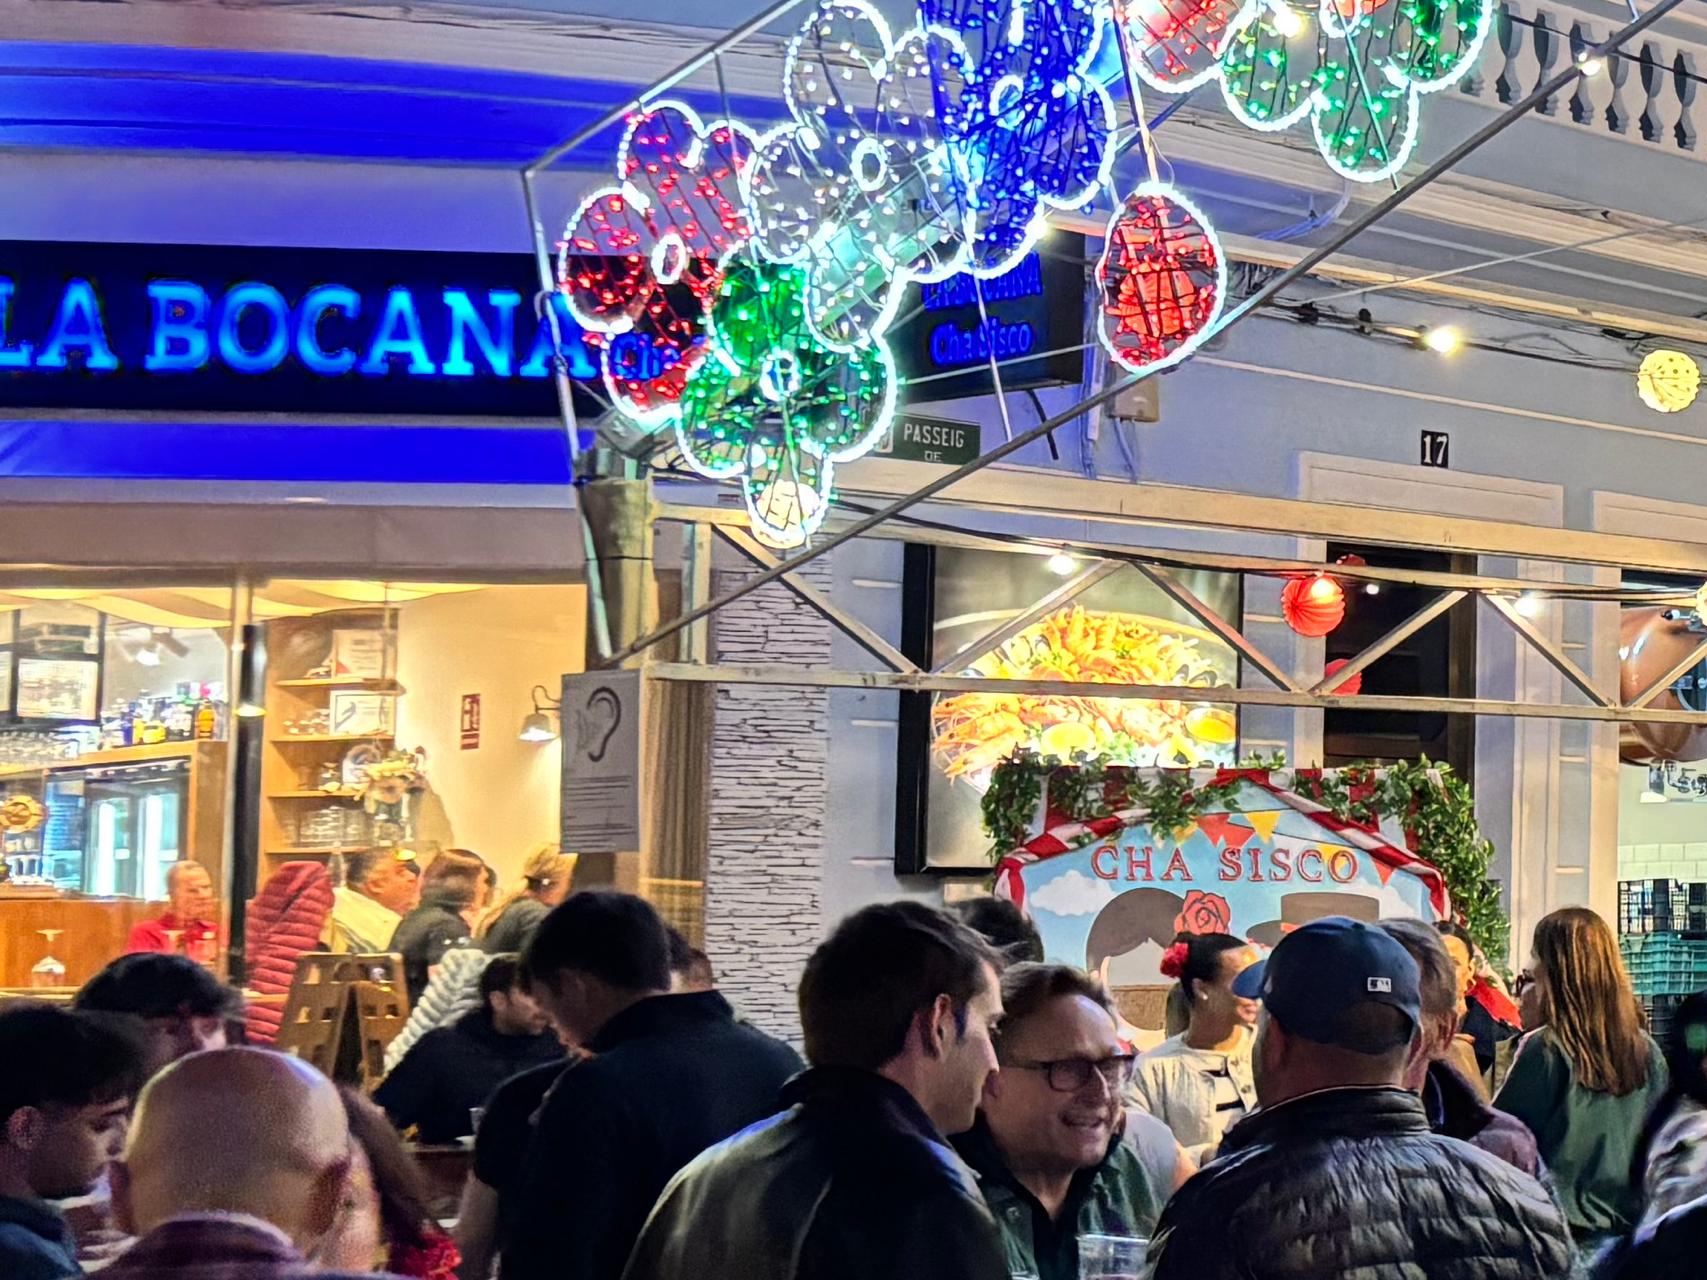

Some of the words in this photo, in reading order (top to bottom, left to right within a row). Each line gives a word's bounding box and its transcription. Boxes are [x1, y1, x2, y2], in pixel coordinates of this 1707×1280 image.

[0, 277, 118, 370] LA
[145, 280, 598, 379] BOCANA
[904, 423, 965, 448] PASSEIG
[1423, 434, 1448, 465] 17
[1091, 845, 1194, 881] CHA
[1218, 846, 1359, 884] SISCO
